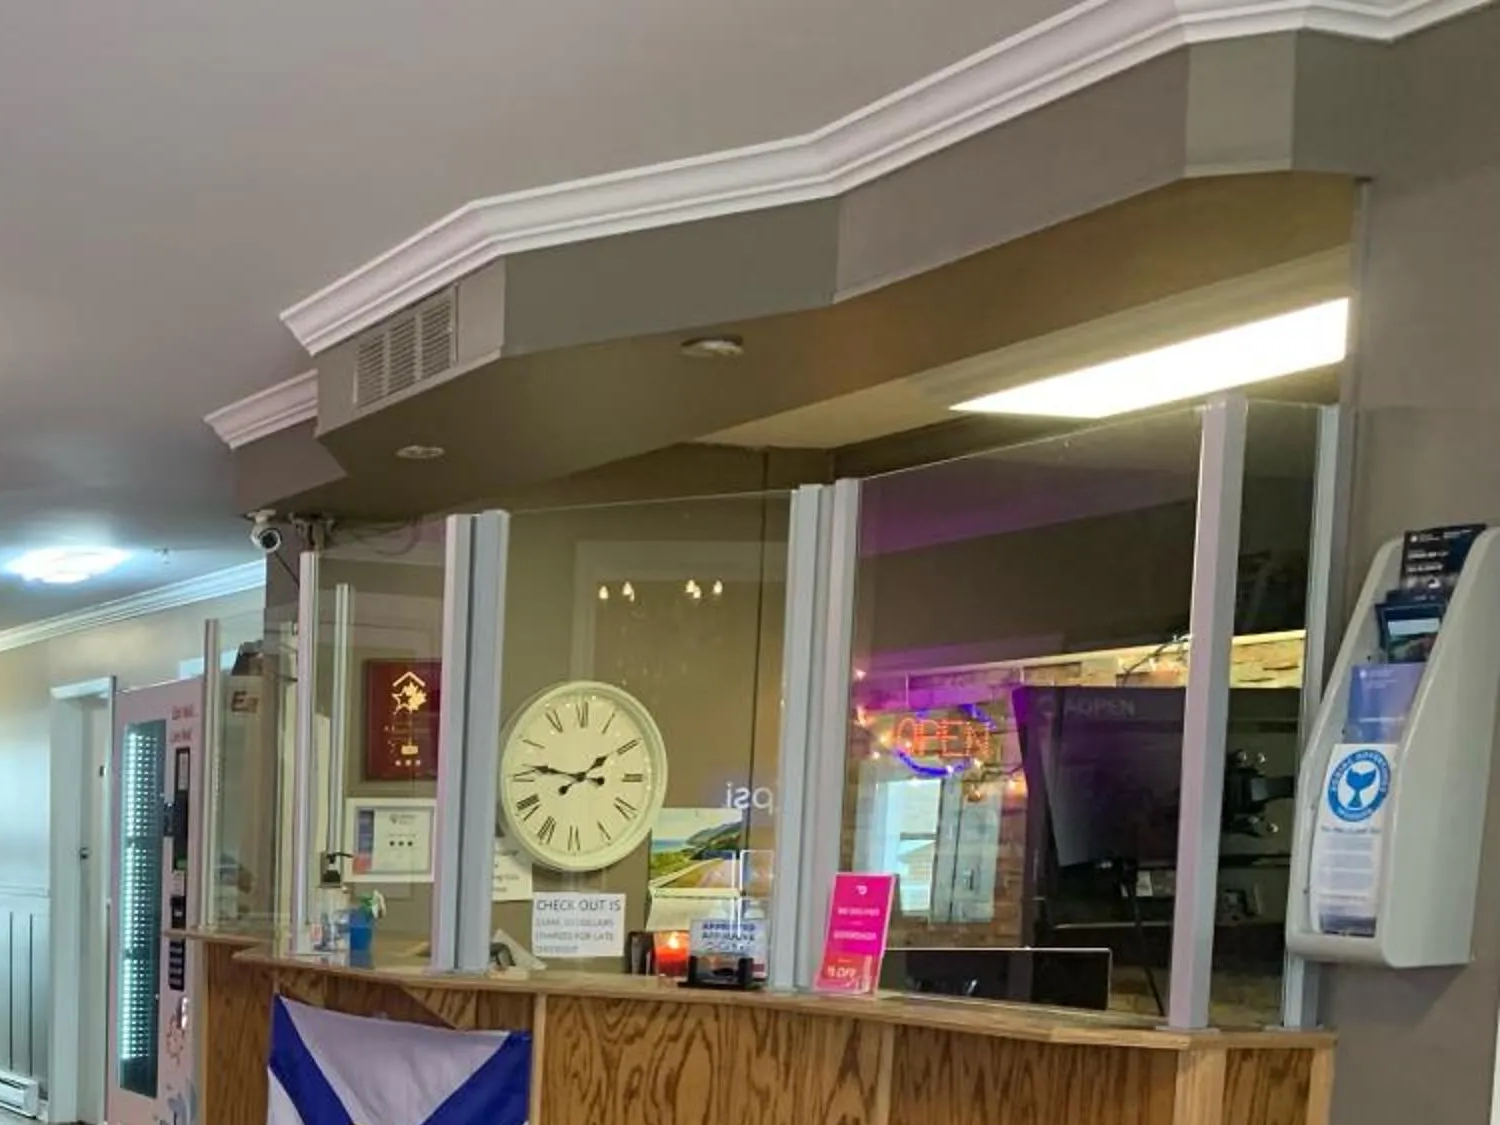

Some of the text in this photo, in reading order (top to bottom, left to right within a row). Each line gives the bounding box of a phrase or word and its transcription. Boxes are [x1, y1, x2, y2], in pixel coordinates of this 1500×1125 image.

[897, 717, 990, 758] OPEN
[536, 899, 621, 911] CHECK OUT IS
